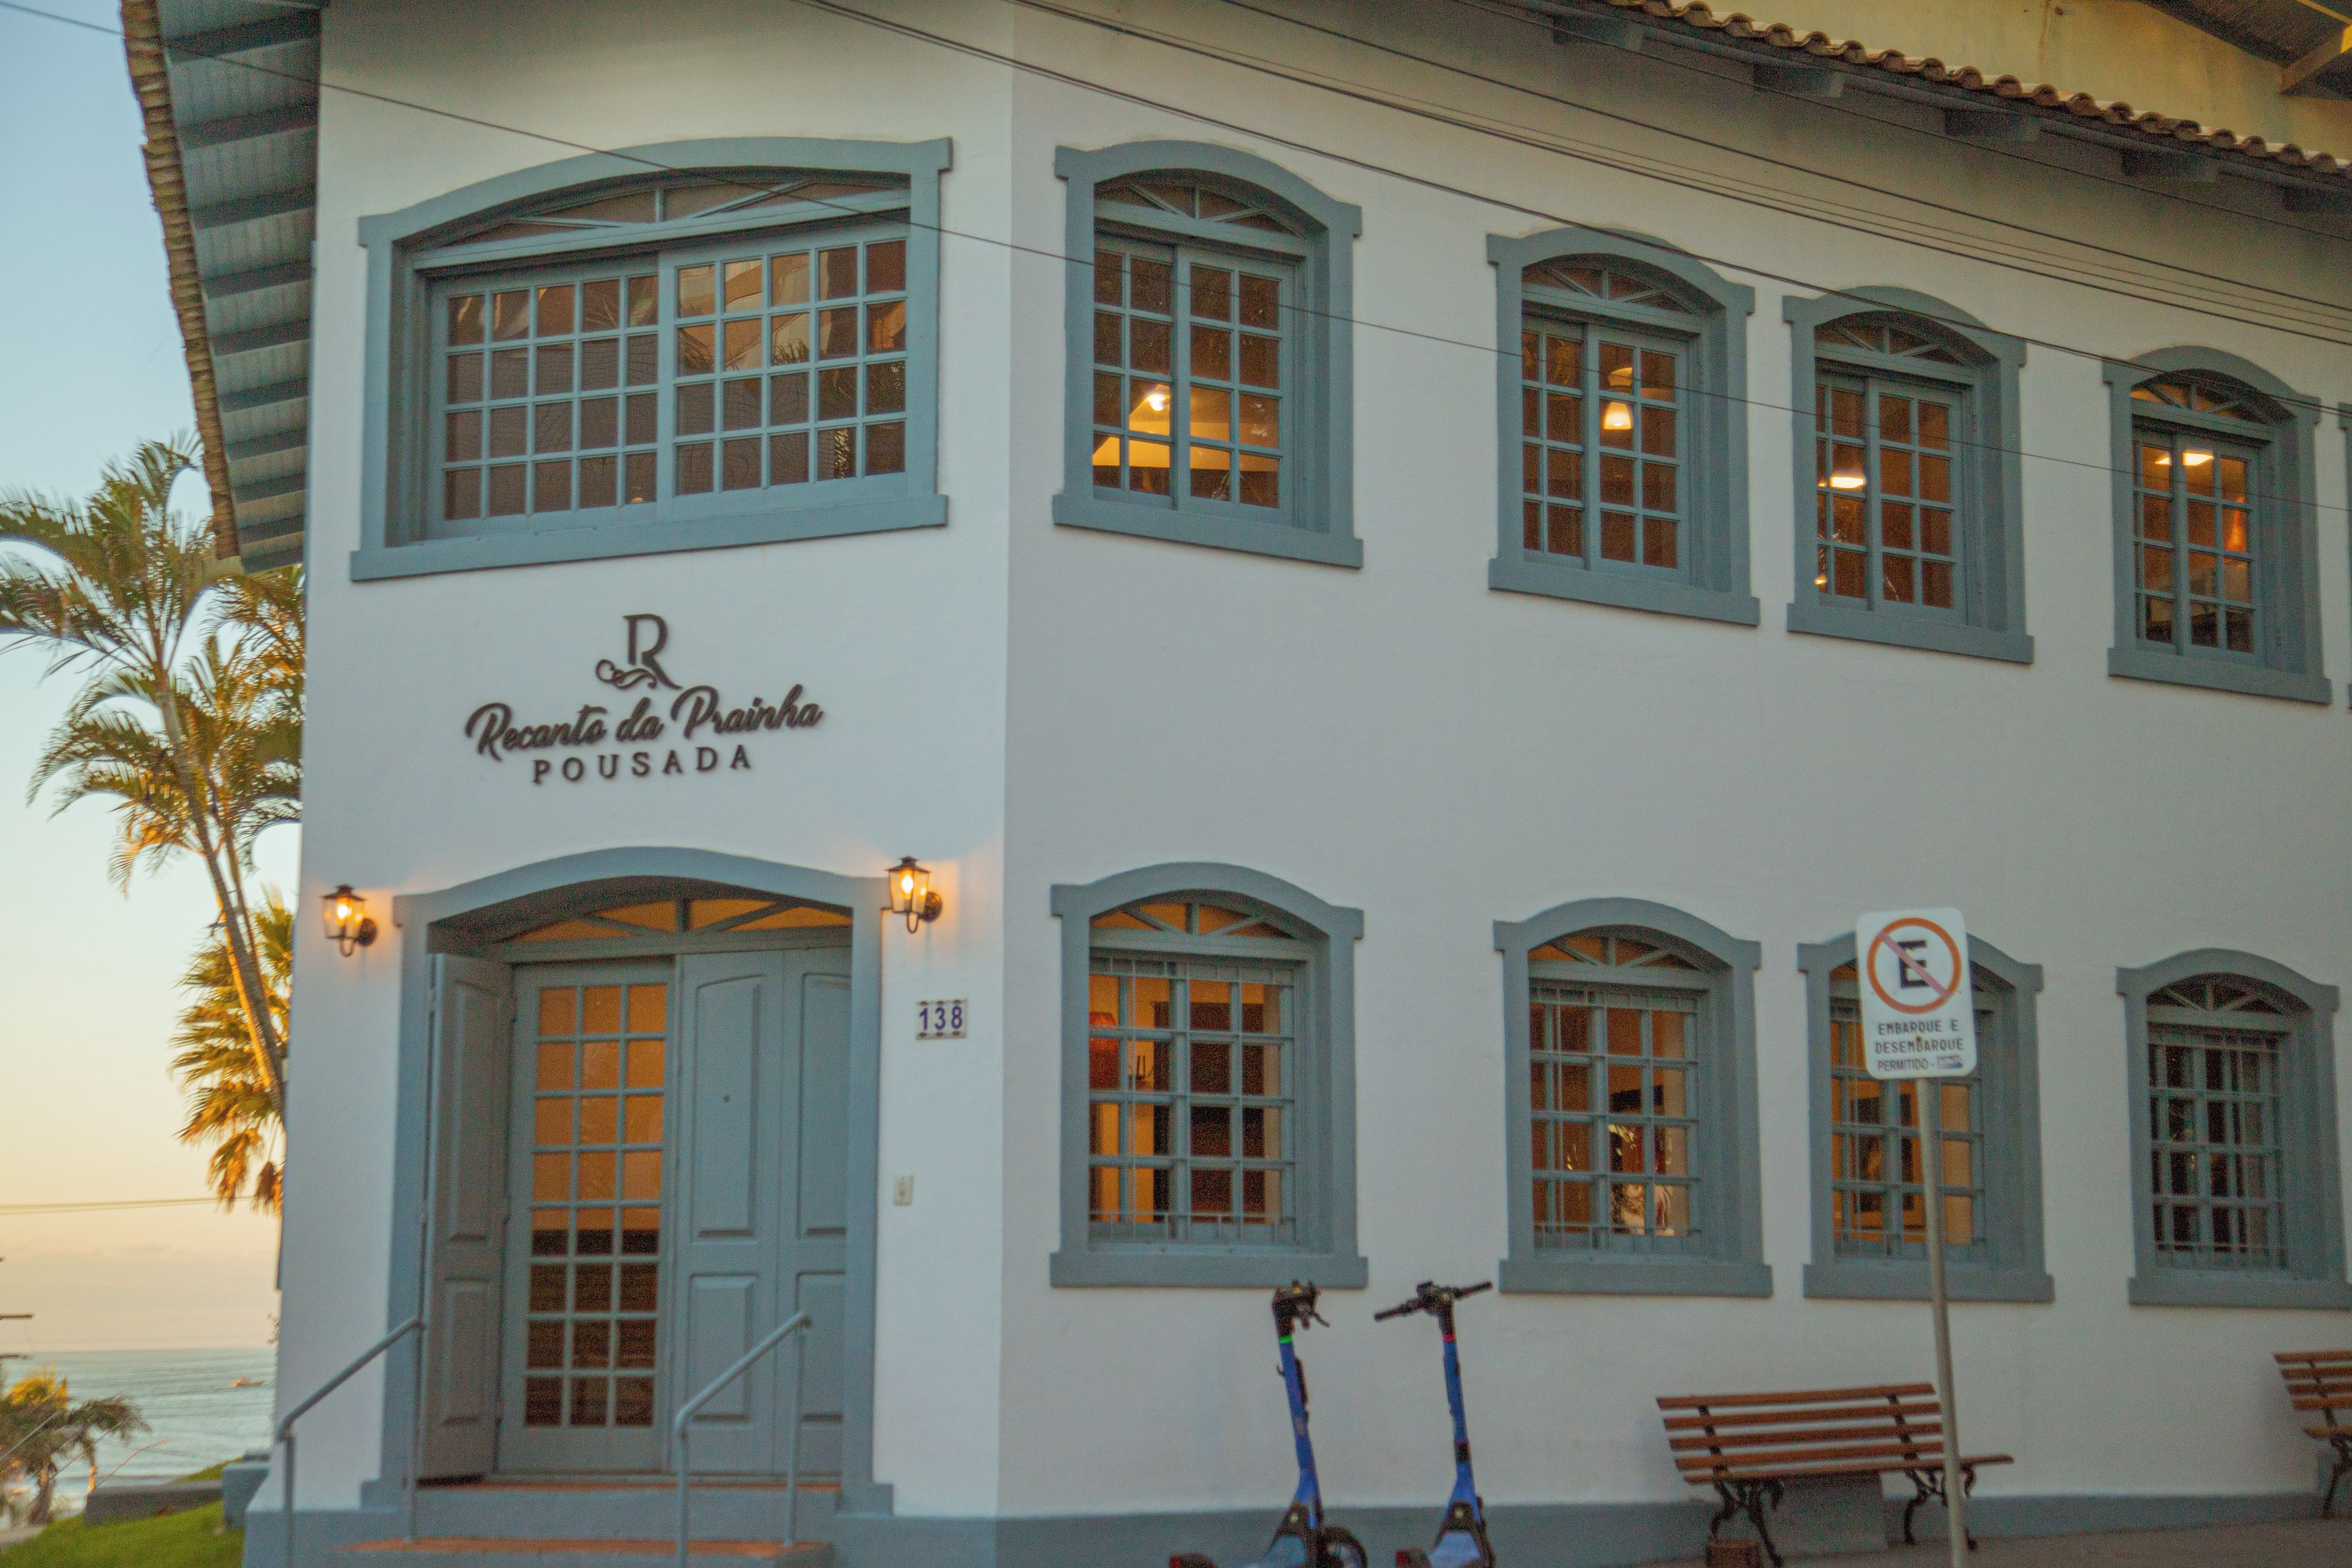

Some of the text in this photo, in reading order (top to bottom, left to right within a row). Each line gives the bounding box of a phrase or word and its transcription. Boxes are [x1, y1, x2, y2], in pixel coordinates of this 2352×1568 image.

[464, 683, 825, 762] Recanto da Prainha
[532, 744, 751, 785] POUSADA
[1898, 939, 1930, 989] E
[919, 1005, 963, 1031] 138
[1877, 1019, 1959, 1036] EMBARQUE E
[1875, 1038, 1964, 1054] DESEMBARQUE
[1877, 1057, 1929, 1072] PERMITIDO
